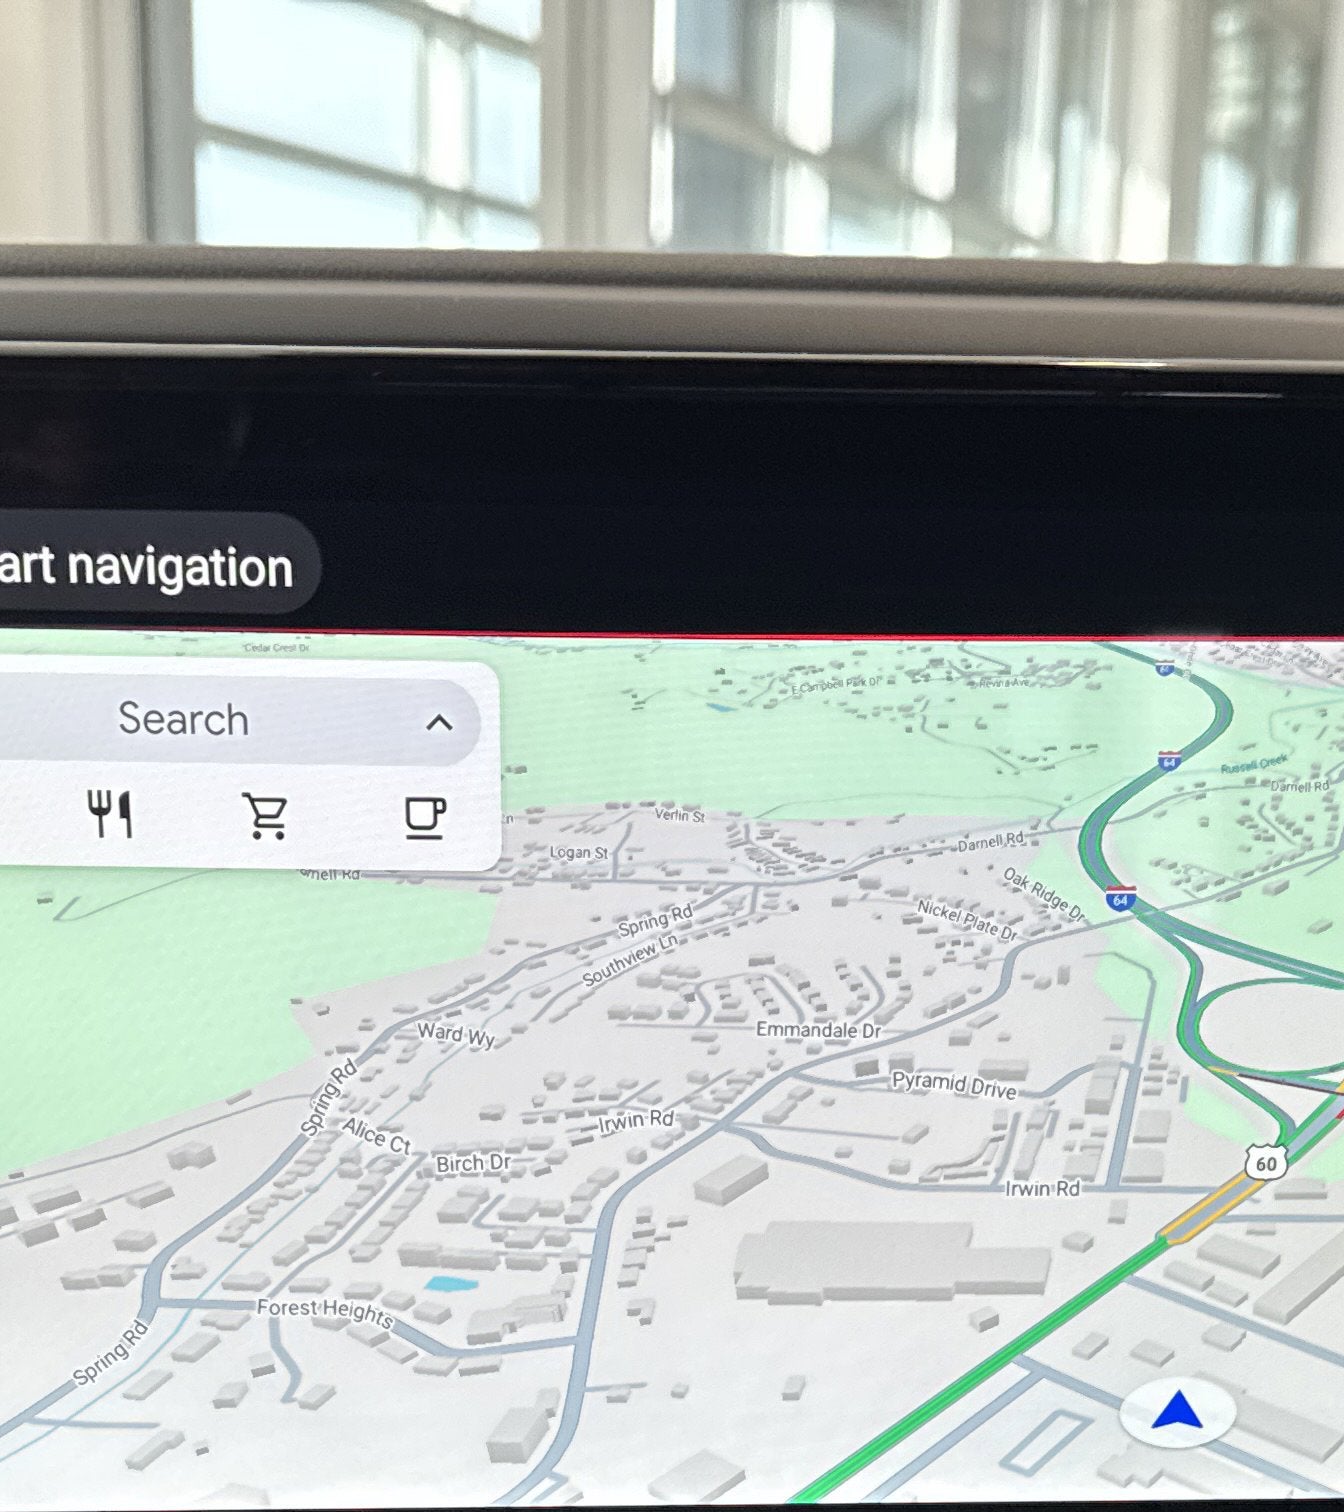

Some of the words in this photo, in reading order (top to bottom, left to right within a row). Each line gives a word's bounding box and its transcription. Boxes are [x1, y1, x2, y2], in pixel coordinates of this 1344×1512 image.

[68, 546, 294, 597] navigation
[118, 700, 250, 739] Search
[1259, 753, 1288, 770] Creek
[1270, 780, 1311, 793] Darnell
[1314, 780, 1330, 792] Rd
[692, 811, 705, 823] St
[550, 846, 591, 862] Logan
[594, 846, 608, 860] St
[958, 836, 1003, 852] Darnell
[1006, 831, 1024, 844] Rd
[1003, 867, 1030, 891] Oak
[1031, 881, 1069, 913] Ridge
[1069, 905, 1086, 923] Dr
[1113, 895, 1128, 907] 64
[618, 913, 669, 938] Spring
[671, 903, 693, 920] Rd
[917, 899, 961, 922] Nickel
[963, 913, 1000, 937] Plate
[1000, 924, 1018, 942] Dr
[582, 943, 656, 988] Southview
[658, 934, 678, 950] Ln
[417, 1021, 462, 1045] Ward
[469, 1030, 496, 1051] Wy
[756, 1020, 856, 1040] Emmandale
[861, 1021, 882, 1039] Dr
[301, 1082, 341, 1137] Spring
[331, 1058, 358, 1085] Rd
[892, 1070, 967, 1098] Pyramid
[972, 1077, 1017, 1101] Drive
[342, 1117, 386, 1147] Alice
[390, 1135, 412, 1155] Ct
[598, 1114, 645, 1133] Irwin
[650, 1109, 675, 1127] Rd
[436, 1156, 484, 1173] Birch
[490, 1153, 511, 1170] Dr
[1255, 1157, 1277, 1173] 60
[1005, 1180, 1052, 1198] Irwin
[1057, 1180, 1081, 1198] Rd
[258, 1298, 317, 1316] Forest
[323, 1301, 394, 1330] Heights
[73, 1341, 130, 1387] Spring
[123, 1319, 149, 1349] Rd
